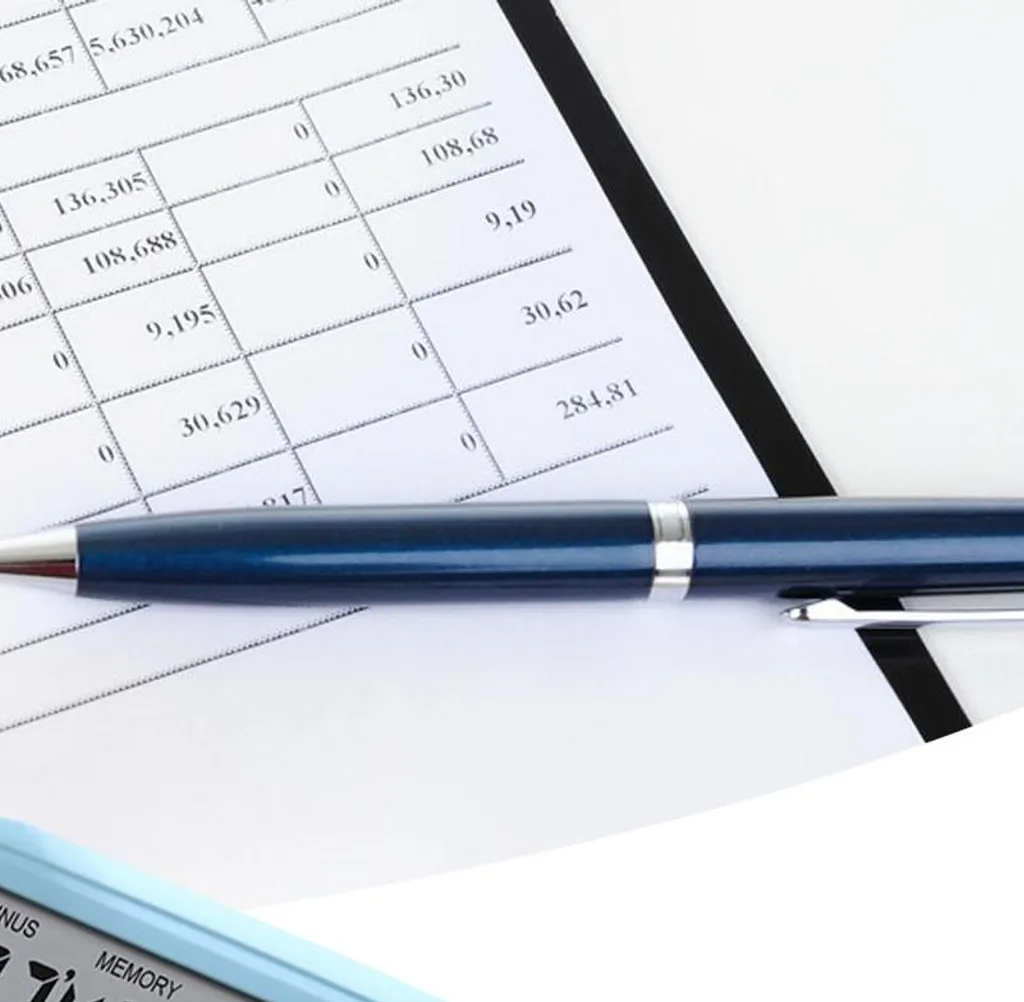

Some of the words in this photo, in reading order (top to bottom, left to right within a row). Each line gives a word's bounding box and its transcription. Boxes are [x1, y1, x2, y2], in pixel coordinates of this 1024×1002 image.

[88, 8, 205, 58] 5,630,204
[388, 69, 468, 109] 136,30
[293, 122, 310, 140] 0
[419, 126, 499, 167] 108,68
[52, 171, 148, 217] 136,305
[324, 179, 341, 198] 0
[485, 199, 537, 232] 9,19
[82, 230, 178, 276] 108,688
[363, 251, 380, 271] 0
[145, 303, 217, 341] 9,195
[521, 289, 589, 326] 30,62
[52, 350, 69, 370] 0
[411, 341, 429, 361] 0
[180, 395, 262, 439] 30,629
[556, 378, 639, 421] 284,81
[97, 444, 114, 463] 0
[459, 431, 477, 453] 0
[95, 951, 183, 1001] MEMORY
